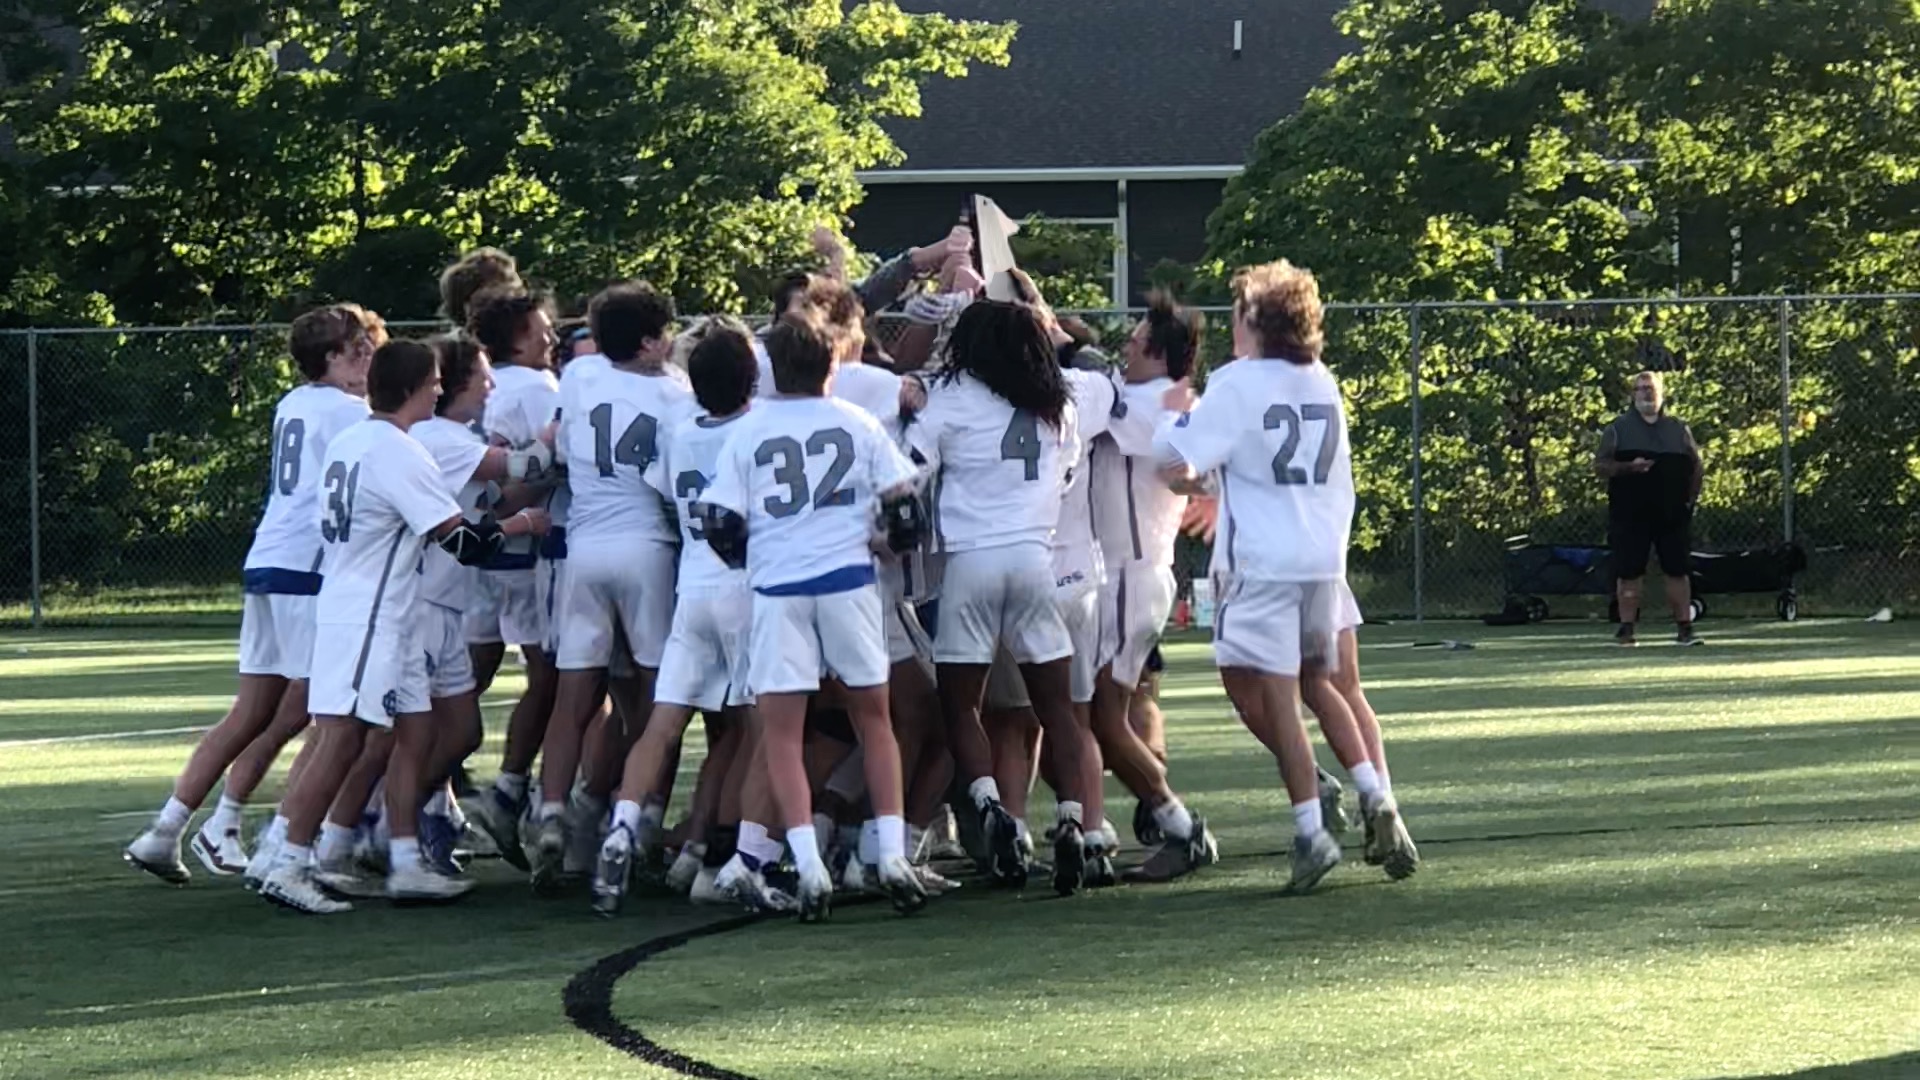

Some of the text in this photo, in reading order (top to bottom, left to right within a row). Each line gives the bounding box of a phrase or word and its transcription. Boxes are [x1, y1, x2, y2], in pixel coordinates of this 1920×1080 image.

[589, 403, 659, 478] 14
[754, 427, 856, 519] 32
[1001, 407, 1041, 481] 4
[1263, 403, 1340, 485] 27
[321, 460, 360, 544] 31
[676, 470, 712, 541] 3
